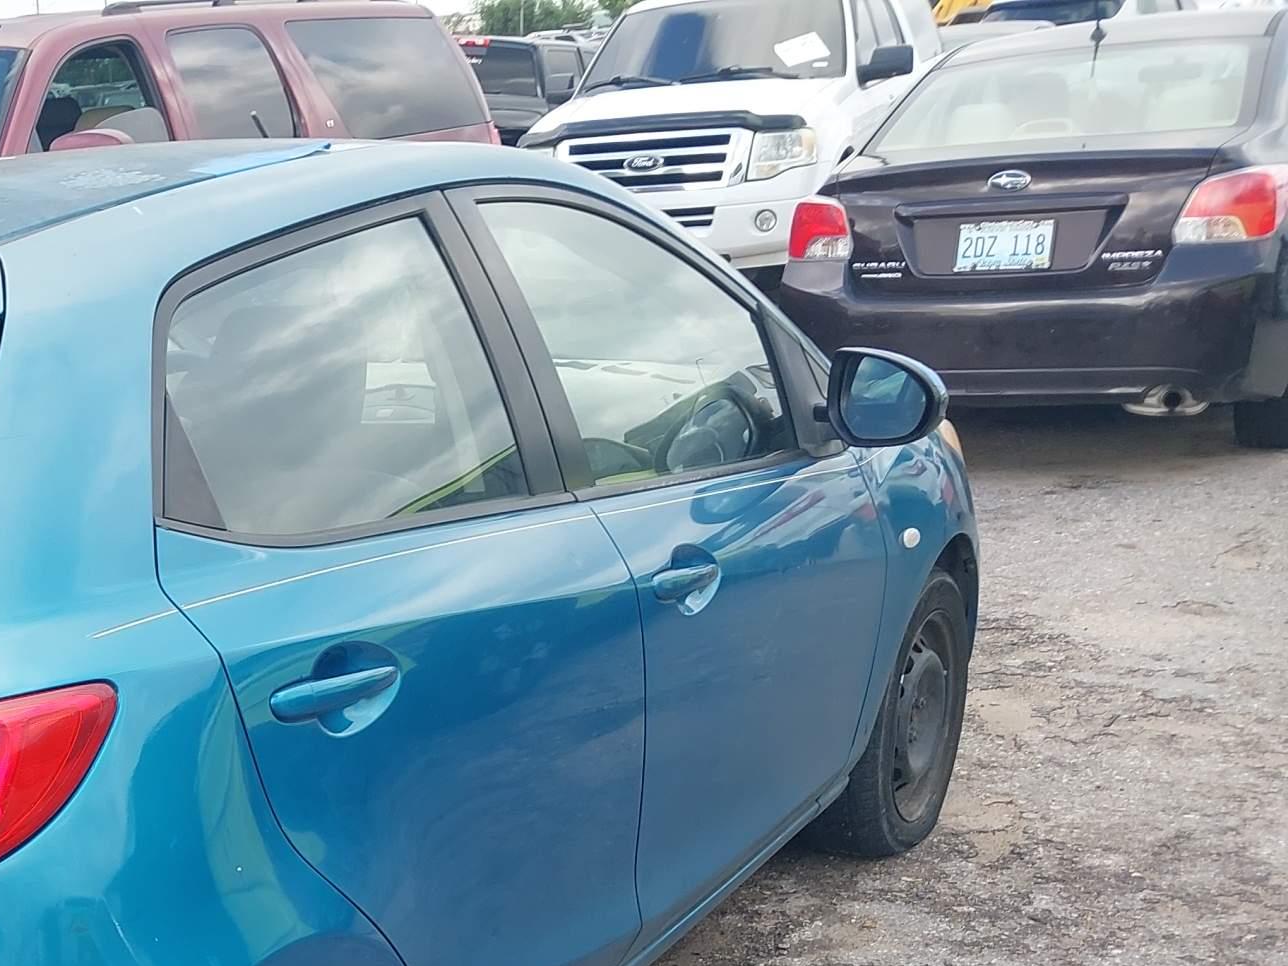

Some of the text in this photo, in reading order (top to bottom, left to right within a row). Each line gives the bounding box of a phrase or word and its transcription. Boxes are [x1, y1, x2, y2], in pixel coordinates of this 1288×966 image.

[1009, 233, 1046, 256] 118
[1101, 249, 1165, 260] IMPREZA
[852, 261, 906, 269] SUBARU
